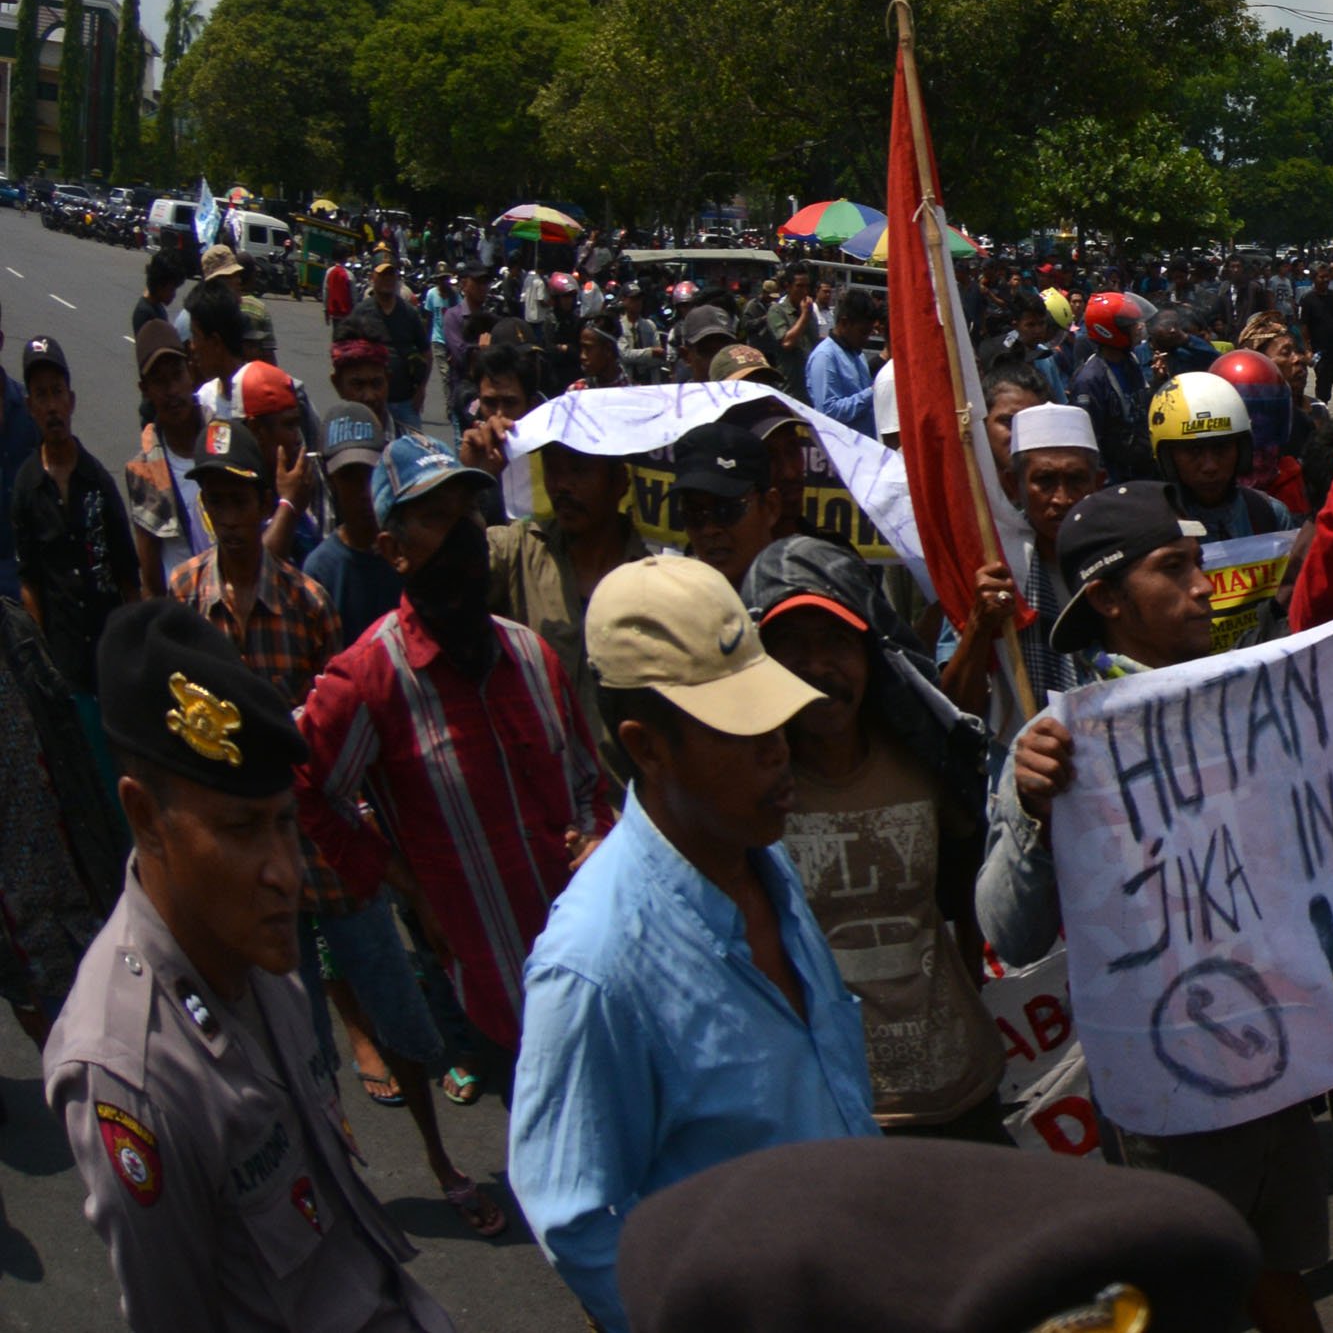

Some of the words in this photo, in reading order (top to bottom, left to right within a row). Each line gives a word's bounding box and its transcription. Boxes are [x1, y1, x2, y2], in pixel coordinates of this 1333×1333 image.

[327, 417, 375, 448] Nikon
[1106, 645, 1328, 843] HUTAN
[1106, 823, 1263, 973] JIKA
